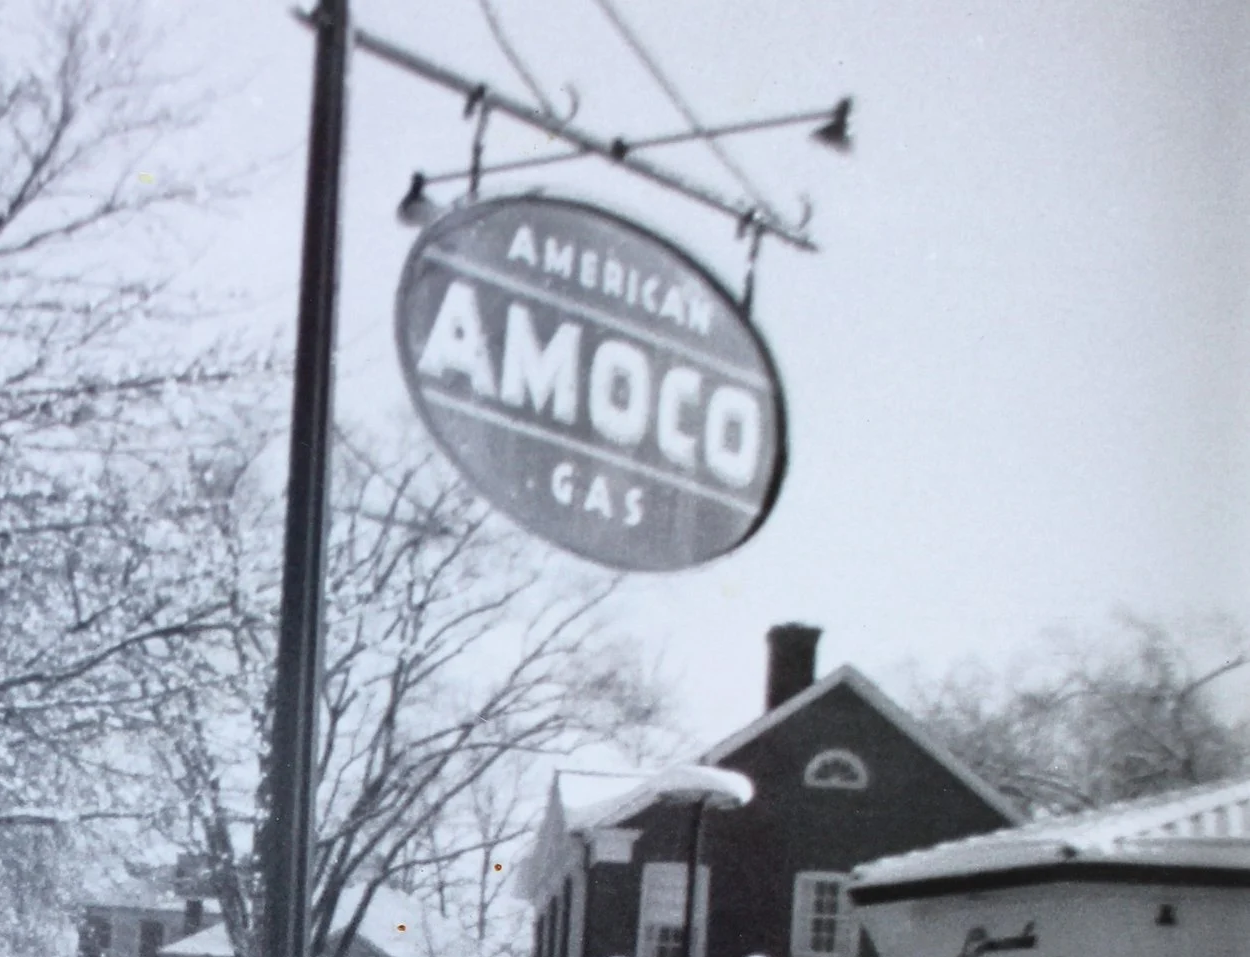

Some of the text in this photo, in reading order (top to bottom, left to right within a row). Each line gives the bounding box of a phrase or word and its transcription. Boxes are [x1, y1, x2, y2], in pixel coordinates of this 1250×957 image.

[507, 225, 712, 335] AMERICAN
[417, 280, 761, 488] AMOCO
[552, 462, 643, 527] GAS
